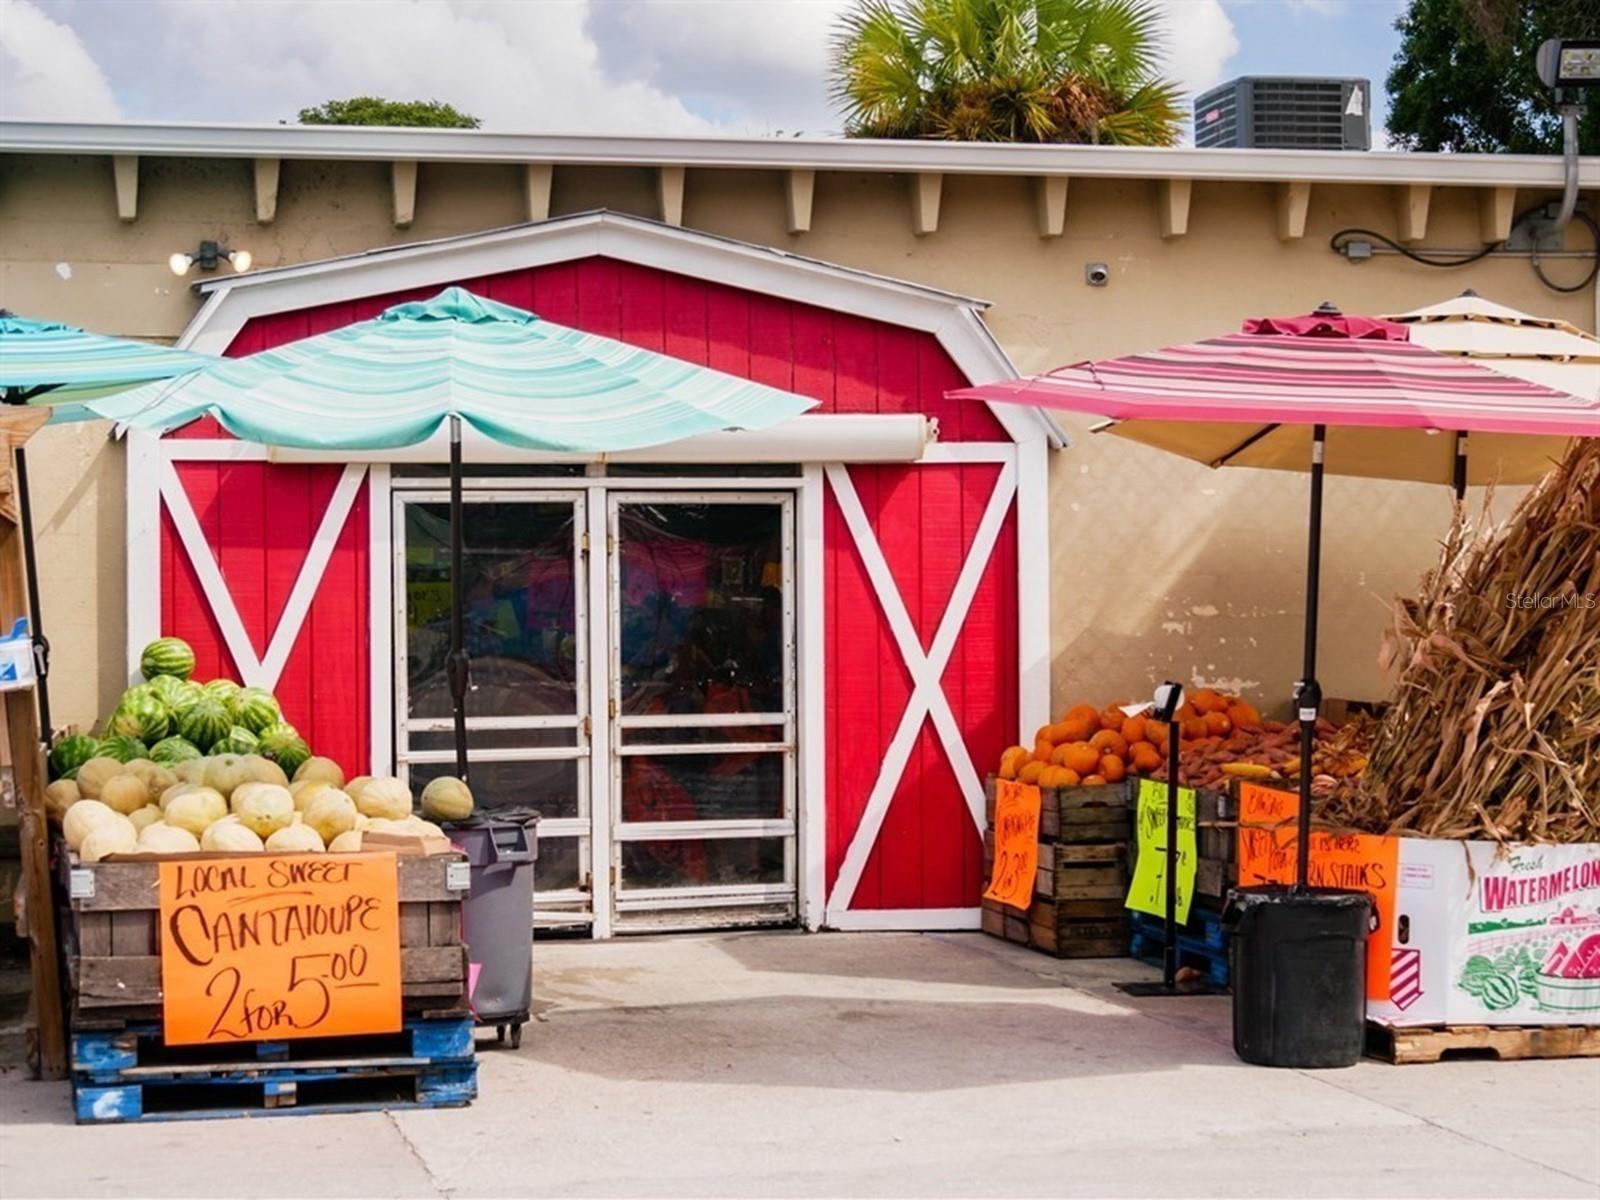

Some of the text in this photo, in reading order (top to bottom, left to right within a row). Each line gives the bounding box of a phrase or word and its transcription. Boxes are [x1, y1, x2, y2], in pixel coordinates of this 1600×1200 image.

[176, 861, 363, 899] LOCAL SWEET
[1509, 855, 1543, 873] Fresh
[206, 967, 248, 1039] 2
[288, 944, 367, 1029] 5.00
